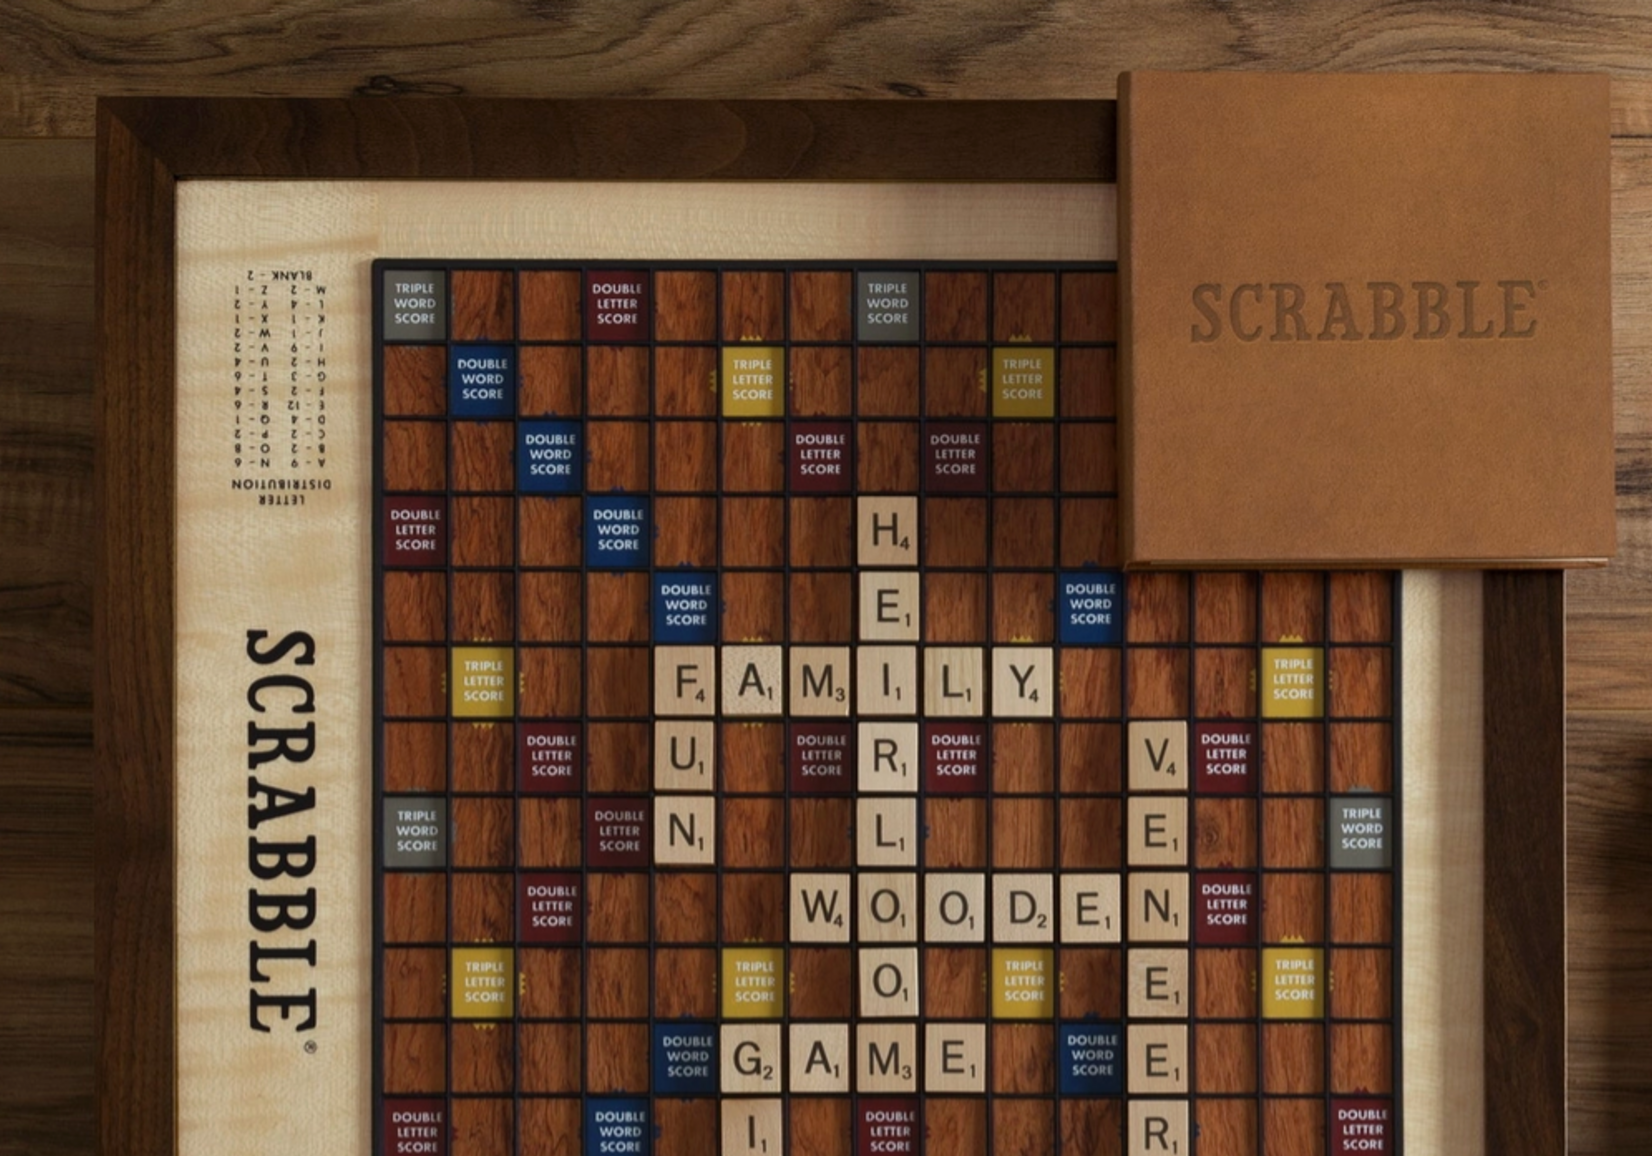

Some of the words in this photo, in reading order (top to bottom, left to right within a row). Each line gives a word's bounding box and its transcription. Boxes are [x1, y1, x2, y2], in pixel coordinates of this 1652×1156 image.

[271, 270, 312, 281] BLANK
[396, 282, 434, 294] TRIPLE
[593, 283, 642, 295] DOUBLE
[868, 283, 907, 294] TRIPLE
[394, 297, 435, 309] WORD
[598, 298, 638, 310] LETTER
[867, 298, 908, 309] WORD
[395, 312, 435, 324] SCORE
[598, 313, 638, 325] SCORE
[868, 312, 909, 324] SCORE
[458, 358, 508, 370] DOUBLE
[734, 359, 772, 370] TRIPLE
[462, 373, 503, 385] WORD
[733, 374, 773, 385] LETTER
[463, 388, 504, 400] SCORE
[733, 389, 773, 401] SCORE
[526, 434, 576, 446] DOUBLE
[796, 434, 845, 445] DOUBLE
[530, 448, 571, 460] WORD
[801, 448, 841, 460] LETTER
[531, 463, 571, 475] SCORE
[801, 463, 842, 475] SCORE
[231, 478, 332, 490] DISTRIBUTION
[257, 493, 305, 506] LETTER
[391, 509, 440, 521] DOUBLE
[594, 509, 643, 521] DOUBLE
[396, 524, 436, 536] LETTER
[598, 524, 639, 536] WORD
[396, 539, 436, 551] SCORE
[599, 539, 639, 551] SCORE
[662, 584, 711, 596] DOUBLE
[1066, 583, 1115, 595] DOUBLE
[666, 599, 707, 611] WORD
[1070, 598, 1111, 610] WORD
[666, 614, 707, 626] SCORE
[1071, 613, 1112, 625] SCORE
[465, 660, 503, 672] TRIPLE
[1275, 658, 1314, 670] TRIPLE
[464, 675, 504, 687] LETTER
[1274, 673, 1314, 685] LETTER
[464, 690, 504, 702] SCORE
[1274, 688, 1314, 700] SCORE
[527, 735, 576, 747] DOUBLE
[932, 734, 981, 746] DOUBLE
[1202, 733, 1251, 745] DOUBLE
[532, 750, 572, 761] LETTER
[937, 749, 977, 761] LETTER
[1207, 748, 1247, 760] LETTER
[532, 764, 572, 776] SCORE
[937, 764, 977, 776] SCORE
[1207, 763, 1247, 775] SCORE
[398, 810, 436, 822] TRIPLE
[1343, 807, 1382, 819] TRIPLE
[396, 825, 437, 837] WORD
[1341, 822, 1382, 834] WORD
[397, 840, 437, 852] SCORE
[1342, 837, 1383, 849] SCORE
[528, 885, 577, 897] DOUBLE
[1202, 884, 1252, 896] DOUBLE
[533, 900, 573, 912] LETTER
[1207, 898, 1247, 910] LETTER
[533, 915, 573, 927] SCORE
[1207, 913, 1248, 925] SCORE
[466, 961, 504, 973] TRIPLE
[736, 961, 774, 972] TRIPLE
[1006, 960, 1044, 971] TRIPLE
[1276, 959, 1315, 970] TRIPLE
[465, 976, 505, 988] LETTER
[736, 976, 775, 987] LETTER
[1005, 975, 1044, 987] LETTER
[1275, 974, 1315, 986] LETTER
[465, 991, 505, 1003] SCORE
[736, 990, 775, 1003] SCORE
[1005, 990, 1044, 1002] SCORE
[1275, 988, 1315, 1001] SCORE
[663, 1035, 713, 1048] DOUBLE
[1068, 1034, 1118, 1046] DOUBLE
[667, 1051, 708, 1062] WORD
[1072, 1049, 1113, 1061] WORD
[668, 1065, 709, 1077] SCORE
[1073, 1064, 1113, 1076] SCORE
[393, 1111, 442, 1123] DOUBLE
[596, 1111, 645, 1123] DOUBLE
[866, 1111, 915, 1123] DOUBLE
[1339, 1109, 1387, 1121] DOUBLE
[398, 1126, 437, 1138] LETTER
[600, 1126, 641, 1138] WORD
[871, 1125, 911, 1137] LETTER
[1343, 1124, 1384, 1136] LETTER
[398, 1141, 438, 1153] SCORE
[601, 1141, 641, 1153] SCORE
[871, 1140, 911, 1152] SCORE
[1343, 1139, 1384, 1151] SCORE
